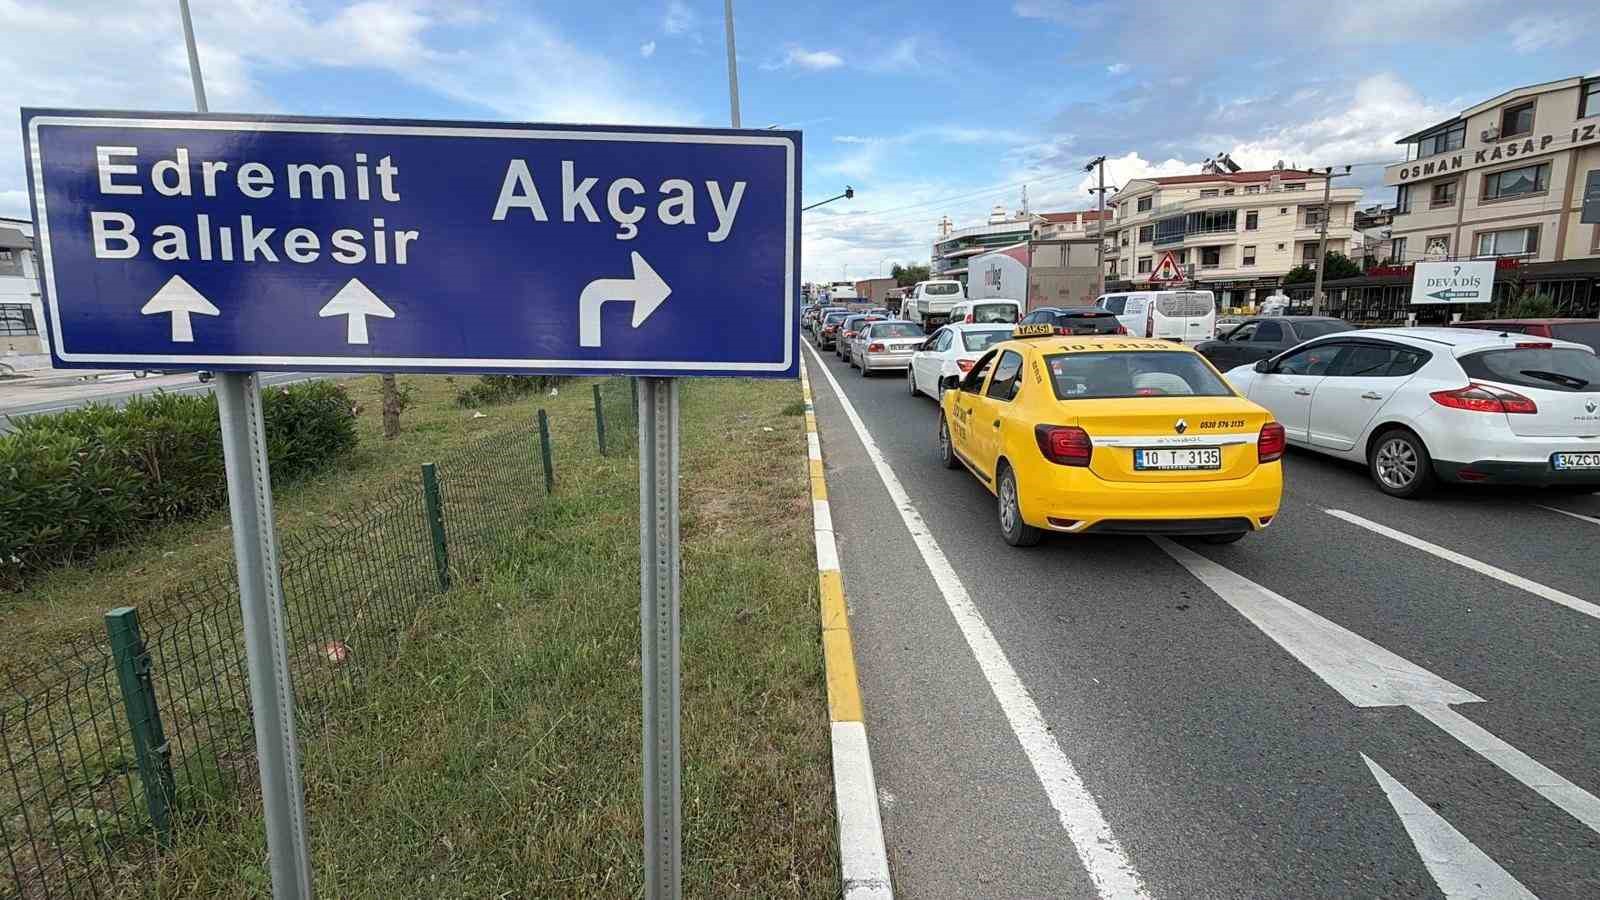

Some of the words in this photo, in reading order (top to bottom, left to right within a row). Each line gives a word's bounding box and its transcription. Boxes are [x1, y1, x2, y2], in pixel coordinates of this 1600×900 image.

[96, 145, 401, 202] Edremit
[1400, 155, 1463, 180] OSMAN
[1474, 135, 1553, 163] KASAP
[1571, 124, 1600, 143] IZ
[491, 158, 748, 241] Akçay
[90, 211, 419, 265] Balıkesir
[1426, 277, 1458, 288] DEVA
[1461, 274, 1481, 288] DİŞ
[1145, 452, 1158, 465] 10
[1170, 451, 1177, 465] T
[1188, 450, 1218, 464] 3135
